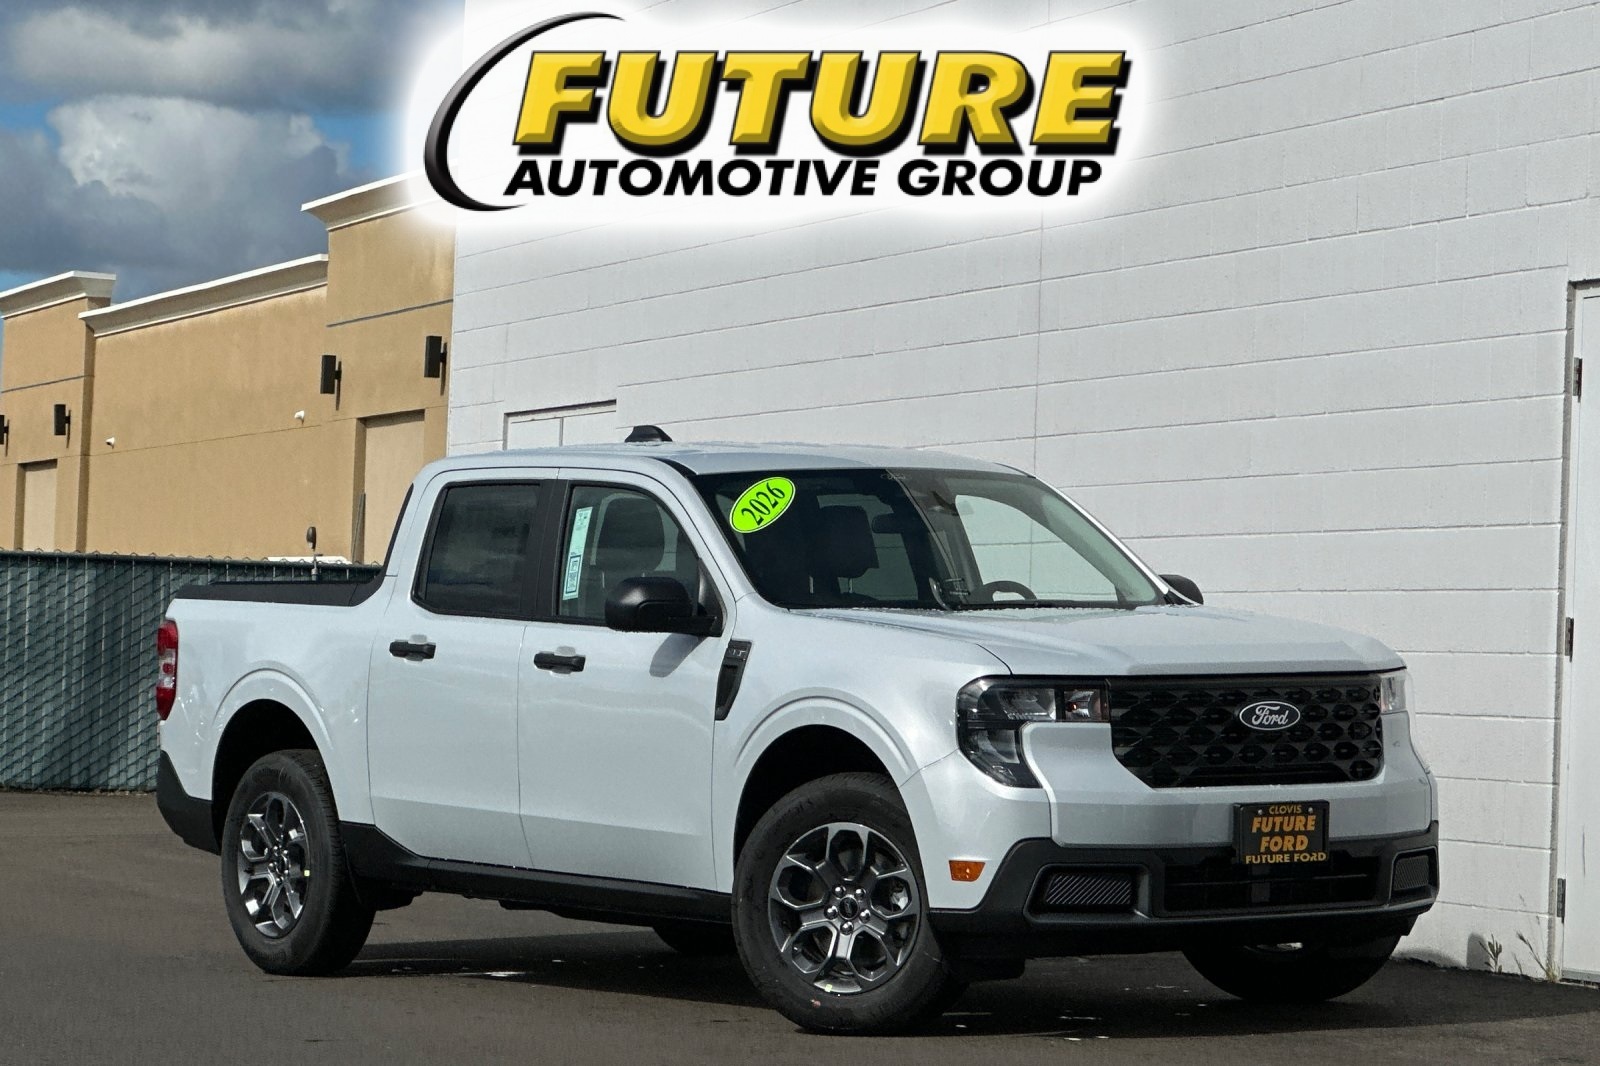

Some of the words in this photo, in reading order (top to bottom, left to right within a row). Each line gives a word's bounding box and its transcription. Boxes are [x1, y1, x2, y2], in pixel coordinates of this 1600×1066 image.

[741, 482, 785, 525] 2026
[1252, 705, 1288, 724] Ford
[1269, 805, 1302, 815] CLOVIS
[1251, 815, 1316, 833] FUTURE
[1260, 835, 1309, 853] FORD
[1245, 854, 1291, 864] FUTURE
[1293, 852, 1327, 862] FORD
